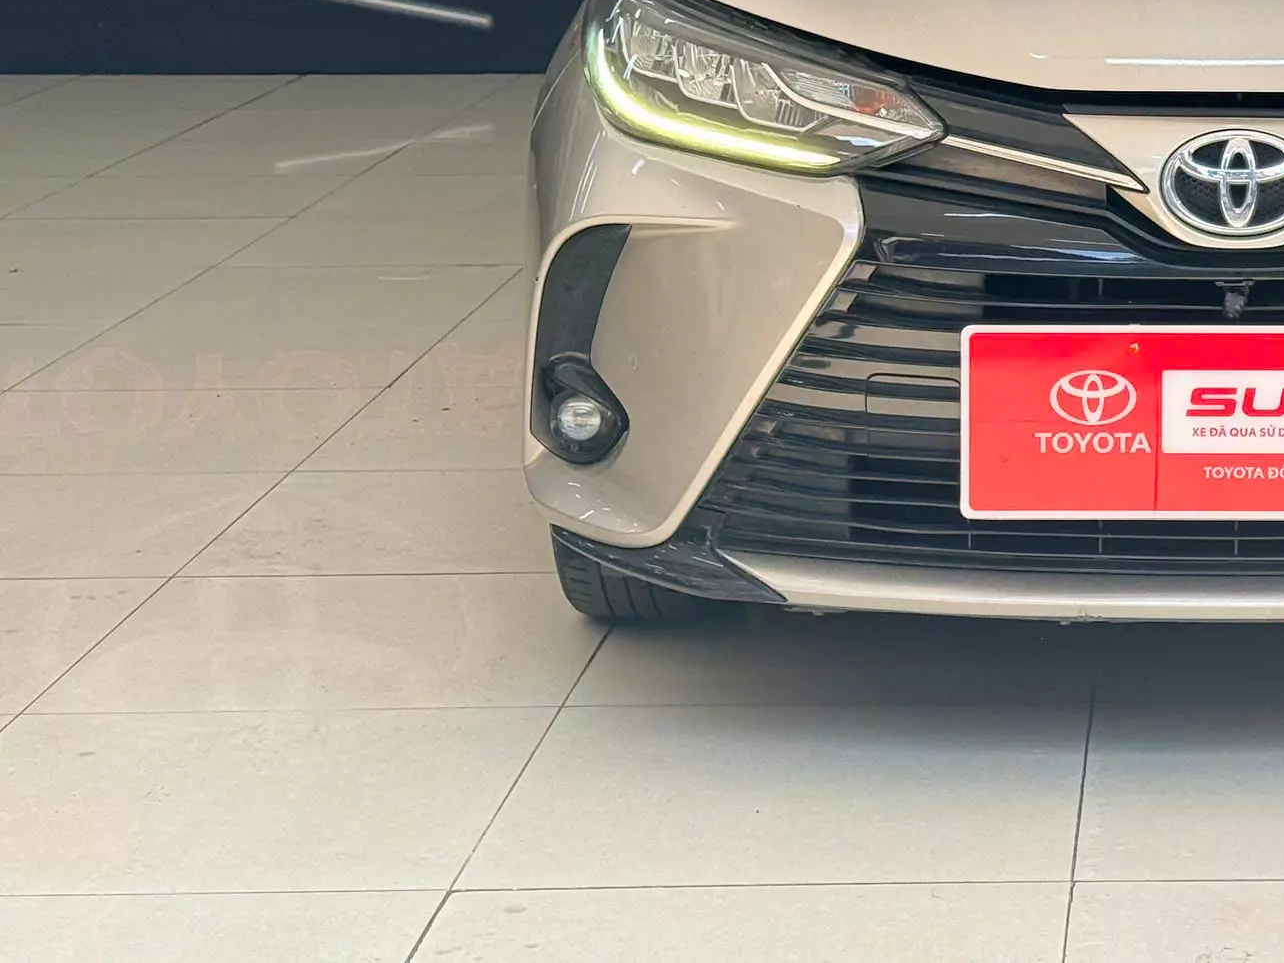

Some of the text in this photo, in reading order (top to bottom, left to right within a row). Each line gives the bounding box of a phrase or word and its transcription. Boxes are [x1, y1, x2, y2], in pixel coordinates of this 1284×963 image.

[1192, 427, 1207, 437] XE
[1209, 424, 1227, 437] ĐÃ
[1229, 427, 1257, 437] QUA
[1259, 424, 1276, 437] SỬ
[1034, 432, 1152, 454] TOYOTA
[1203, 466, 1265, 480] TOYOTA
